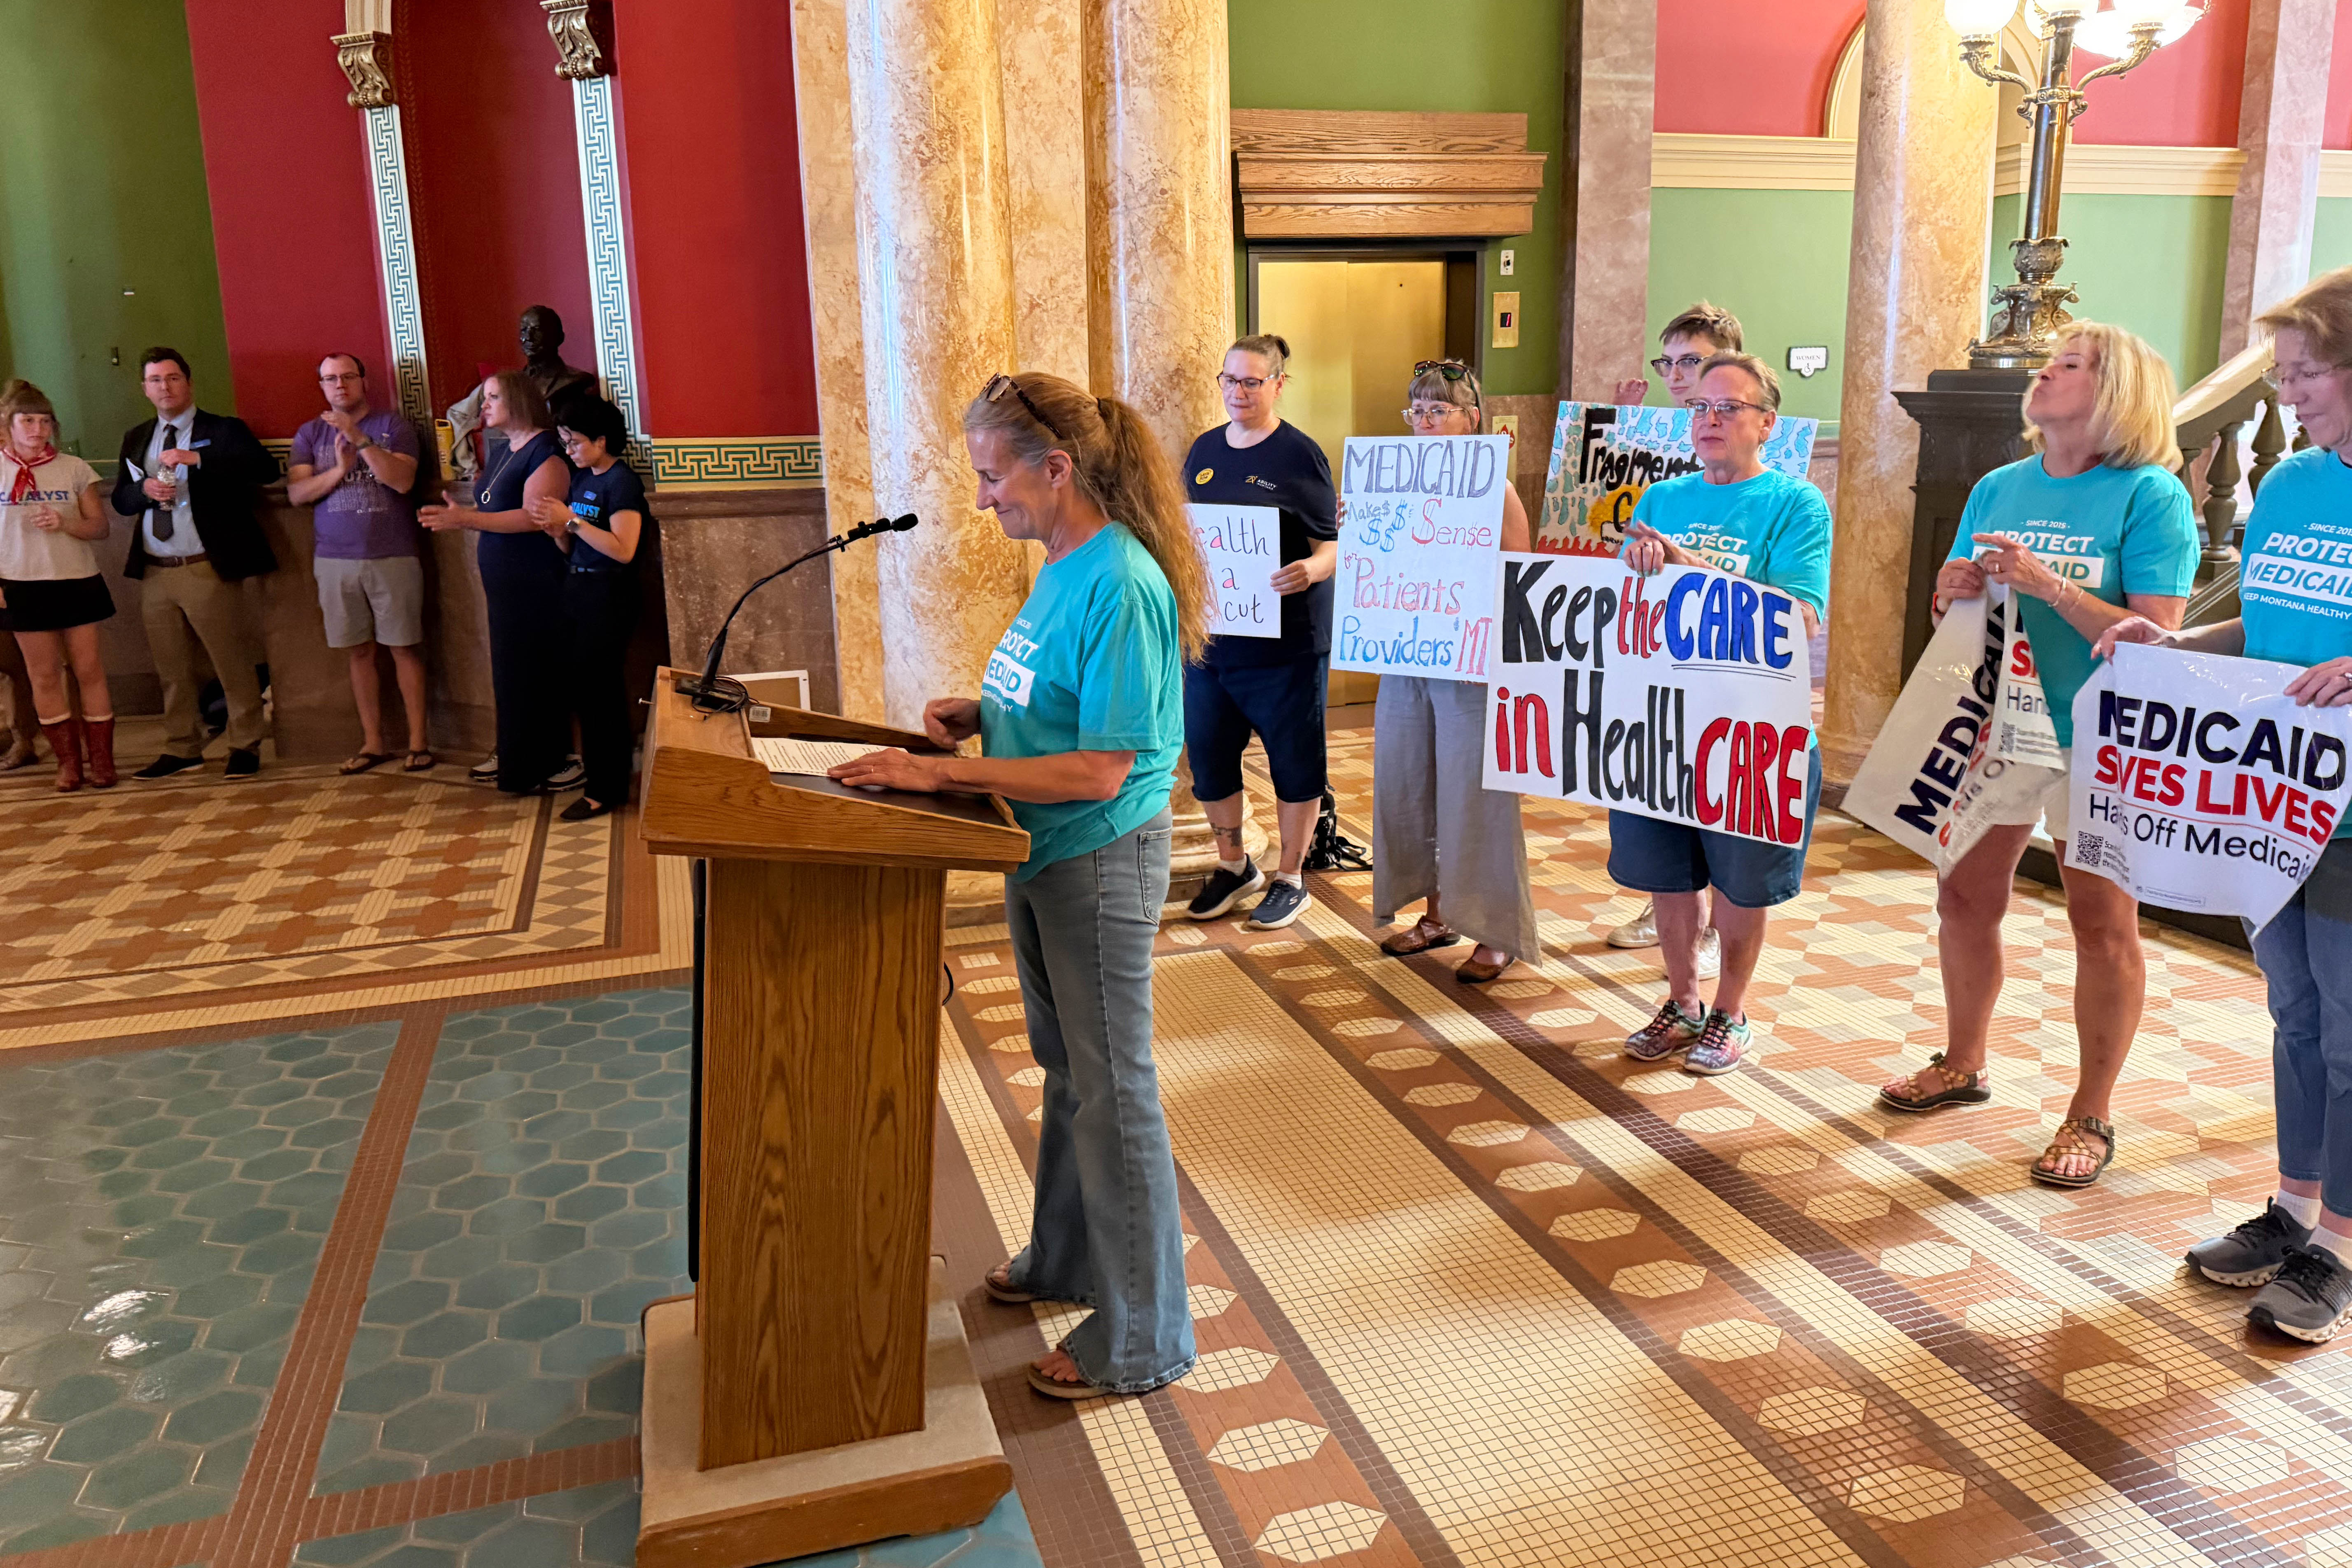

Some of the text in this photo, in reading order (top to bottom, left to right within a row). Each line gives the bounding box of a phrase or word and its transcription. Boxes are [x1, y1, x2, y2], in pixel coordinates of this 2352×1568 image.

[1344, 440, 1495, 498] MEDICAID
[2308, 523, 2337, 533] SINCE
[1344, 551, 1358, 569] for
[2262, 532, 2352, 564] PROTE
[1222, 568, 1239, 590] a
[1353, 557, 1465, 615] Patients
[1225, 594, 1263, 623] cut
[1502, 560, 1793, 669] Keep the CARE
[2260, 595, 2305, 611] MONTANA
[2307, 604, 2352, 620] HEALTHY
[1339, 615, 1454, 667] Providers
[1454, 617, 1493, 676] MT
[1496, 686, 1556, 778] in
[2094, 744, 2188, 807] SVES
[2195, 769, 2337, 846] LIVES
[2134, 813, 2178, 848] Off
